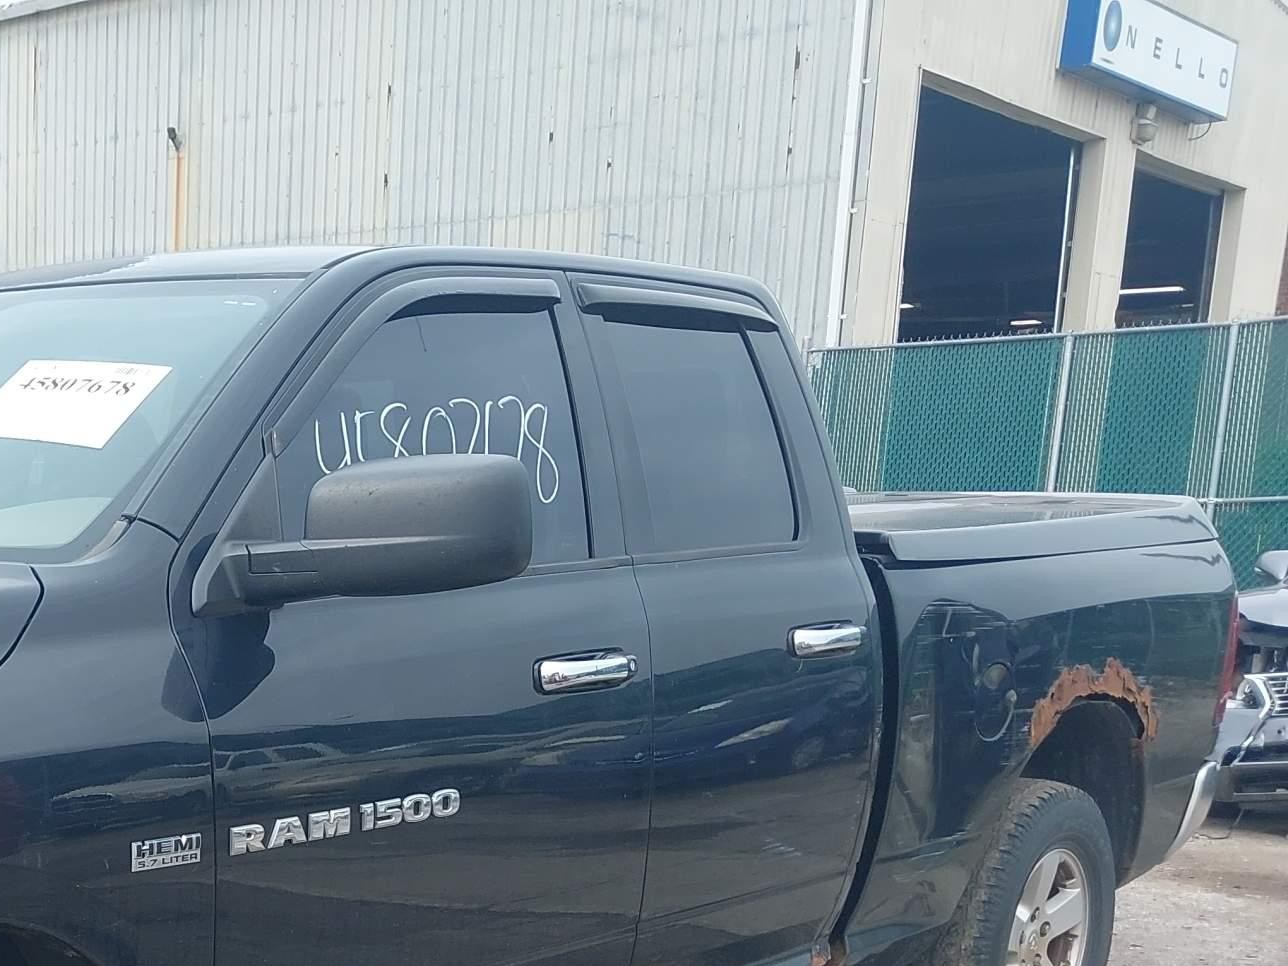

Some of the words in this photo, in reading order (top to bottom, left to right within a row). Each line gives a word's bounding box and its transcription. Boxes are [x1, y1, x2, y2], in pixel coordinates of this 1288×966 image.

[18, 375, 136, 397] 45807678
[229, 806, 351, 857] RAM
[358, 788, 461, 831] 1500
[135, 835, 201, 858] HEMI
[137, 858, 158, 869] 5.7
[161, 852, 198, 865] LITER
